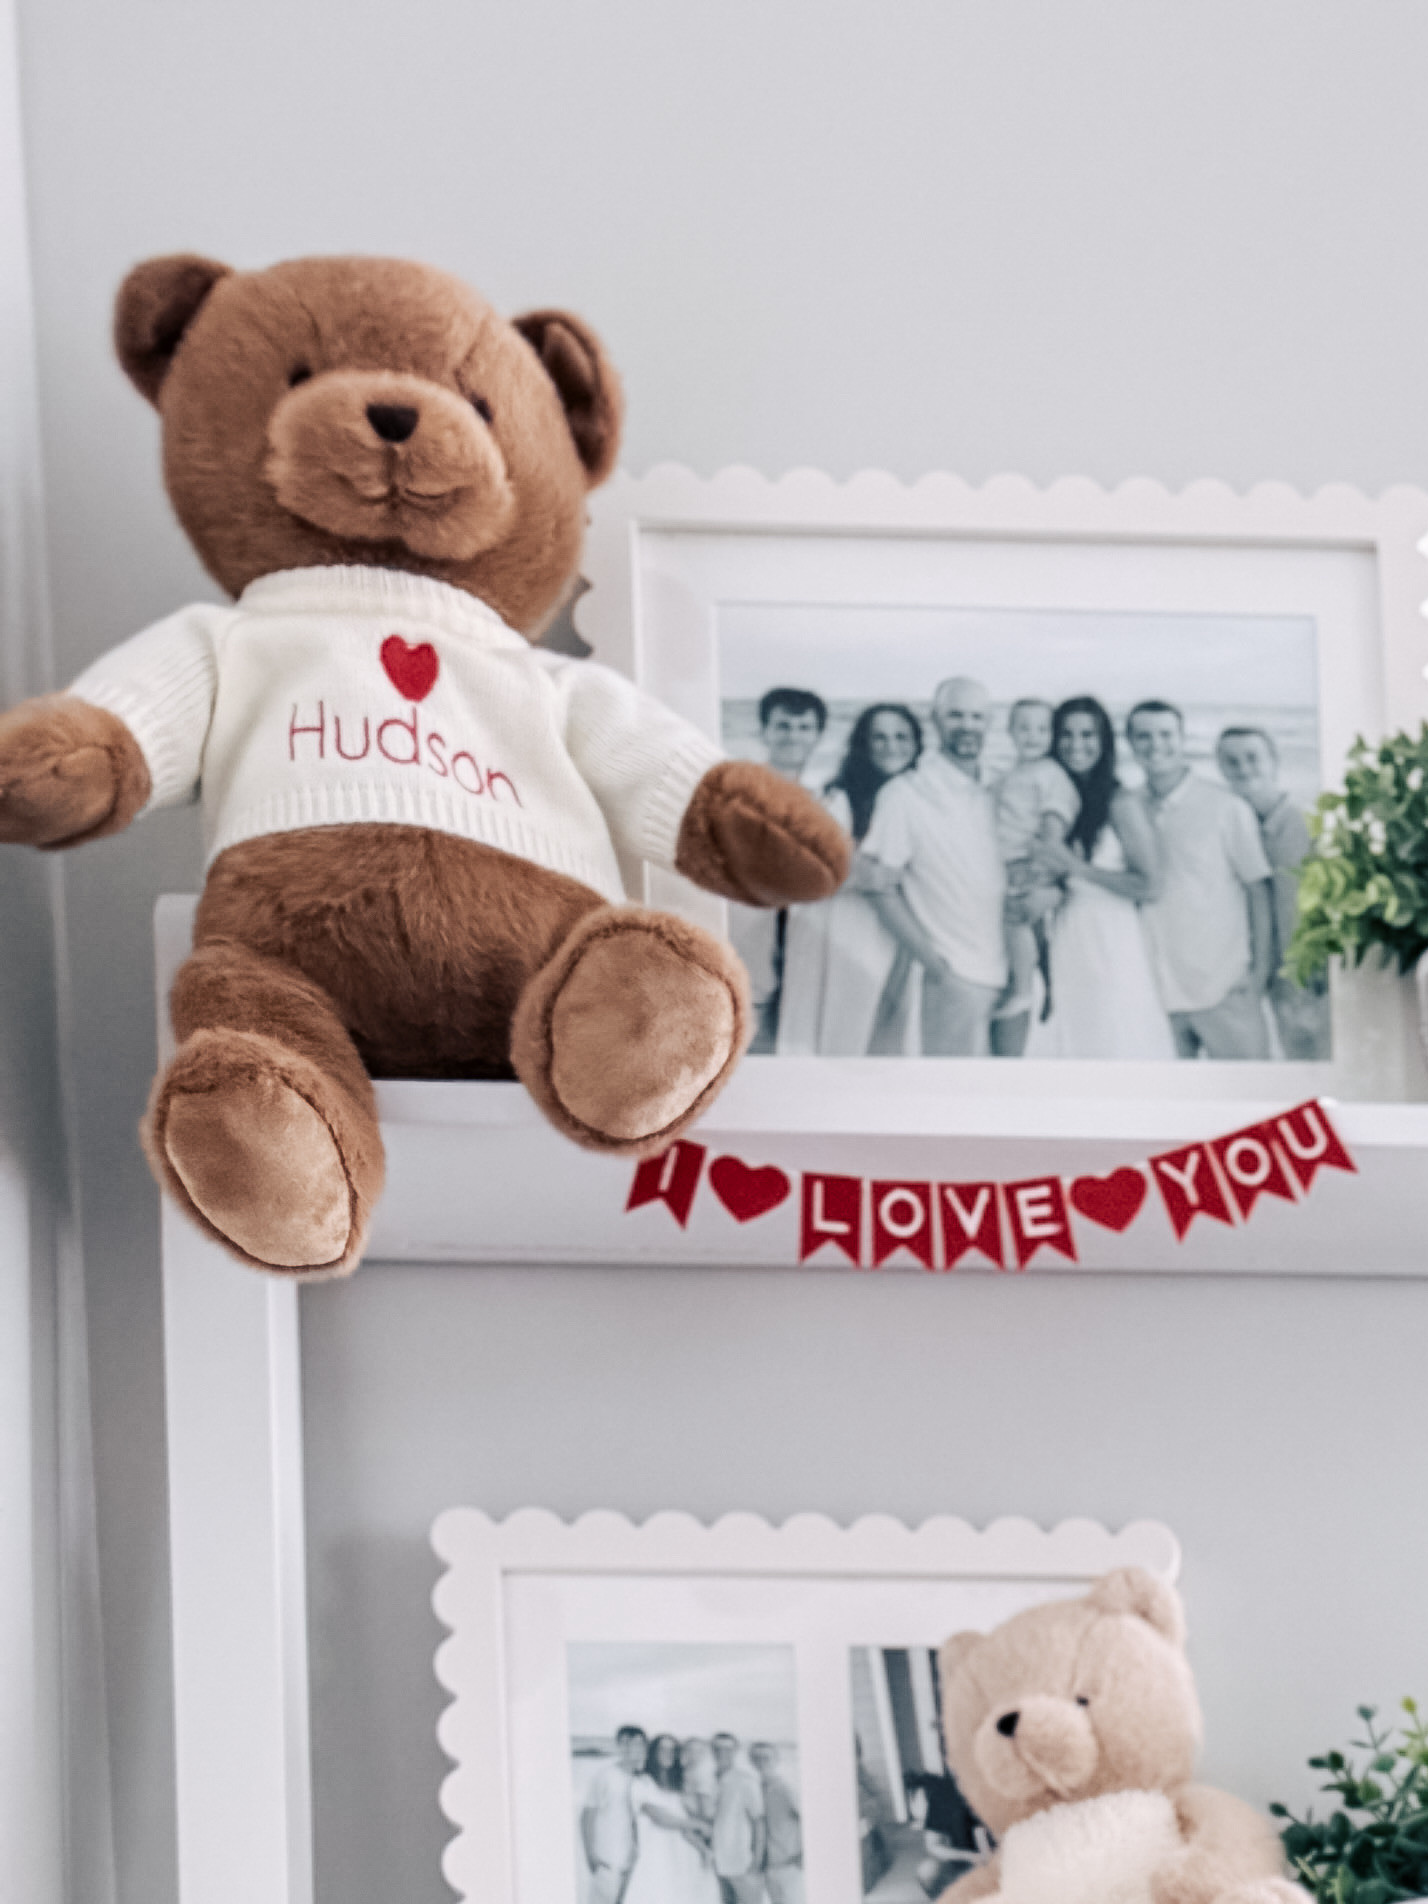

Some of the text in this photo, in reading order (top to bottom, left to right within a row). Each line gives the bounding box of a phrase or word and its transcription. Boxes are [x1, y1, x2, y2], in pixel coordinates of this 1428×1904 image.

[288, 700, 524, 808] Hudson
[656, 1098, 1332, 1240] I LOVE YOU
